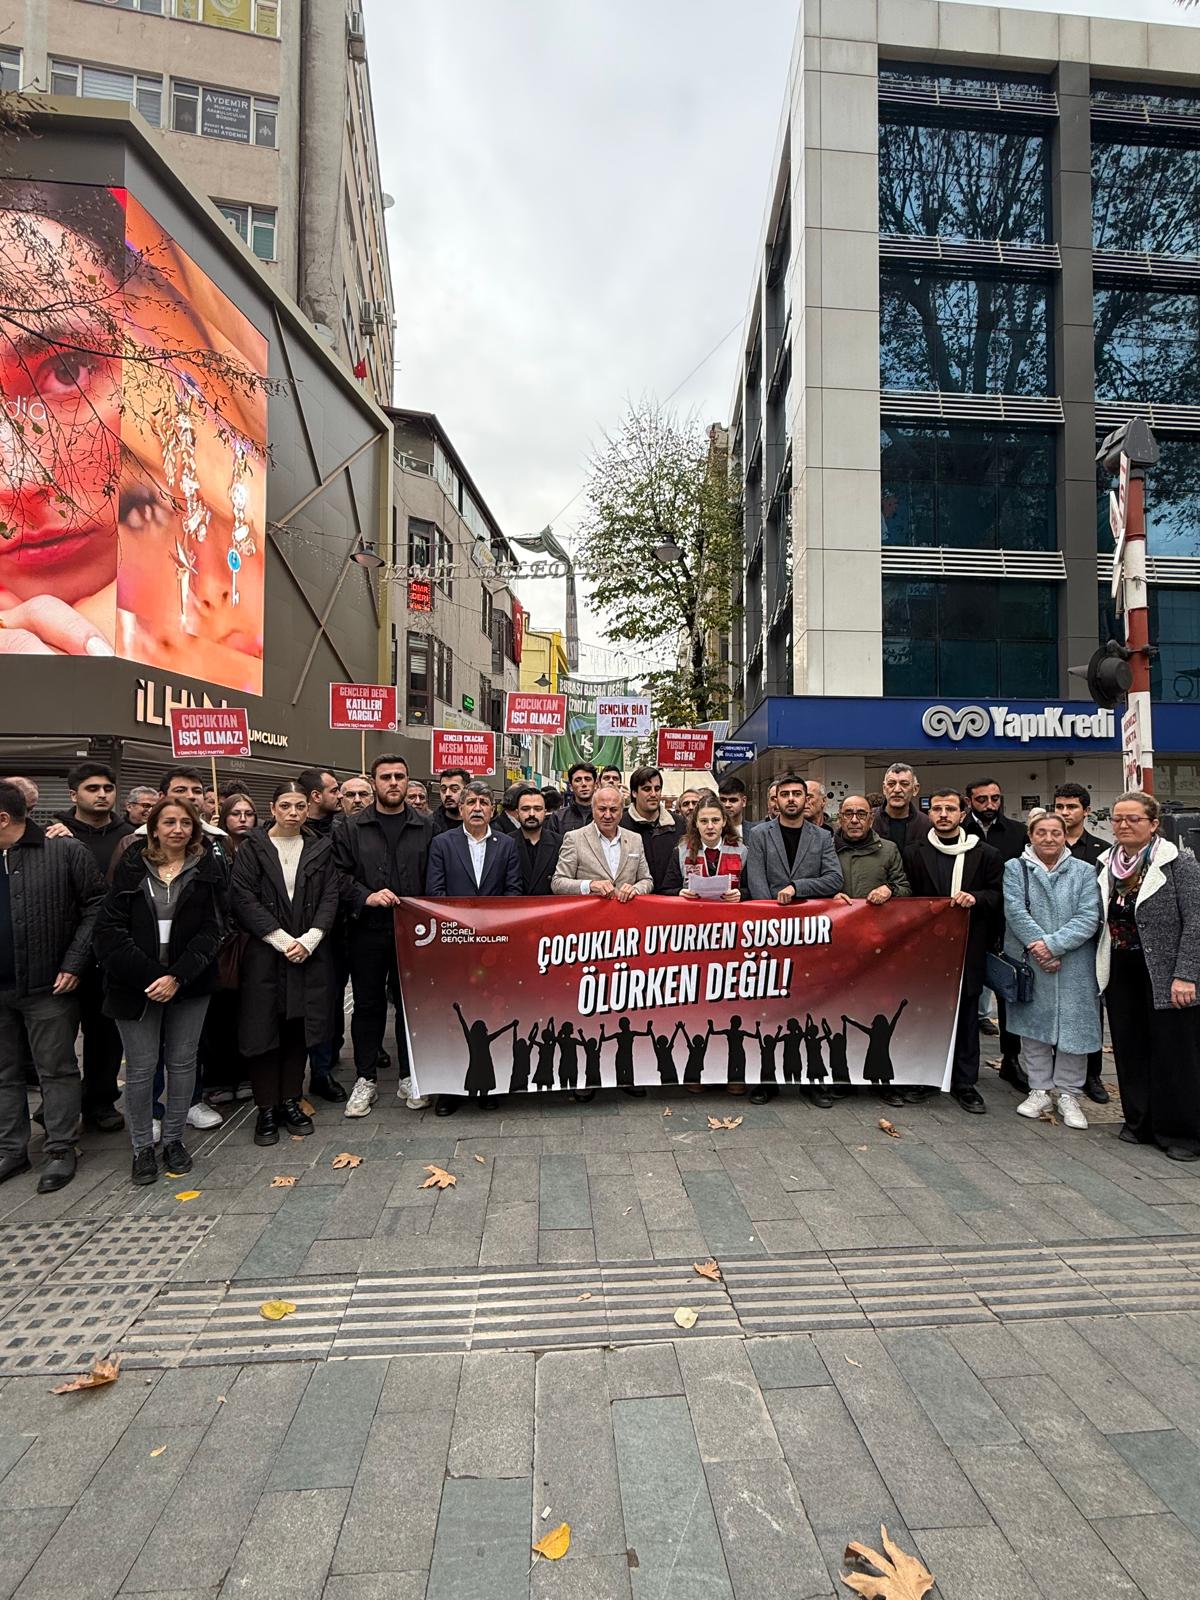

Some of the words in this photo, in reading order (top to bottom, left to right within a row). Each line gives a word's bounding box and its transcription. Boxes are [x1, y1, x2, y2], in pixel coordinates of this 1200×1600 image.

[347, 709, 382, 721] YARGILA!
[631, 703, 648, 715] BİAT
[530, 712, 561, 725] OLMAZ!
[611, 716, 637, 728] ETMEZ!
[989, 706, 1115, 742] YapıKredi
[203, 730, 243, 745] OLMAZ!
[438, 742, 463, 754] MESEM
[465, 742, 489, 755] TARİHE
[441, 927, 476, 935] KOCAELİ
[441, 935, 475, 944] GENÇLİK
[537, 927, 640, 974] ÇOCUKLAR
[644, 921, 737, 954] UYURKEN
[740, 915, 831, 948] SUSULUR
[577, 962, 698, 1015] ÖLÜRKEN
[705, 951, 791, 1000] DEĞİL!
